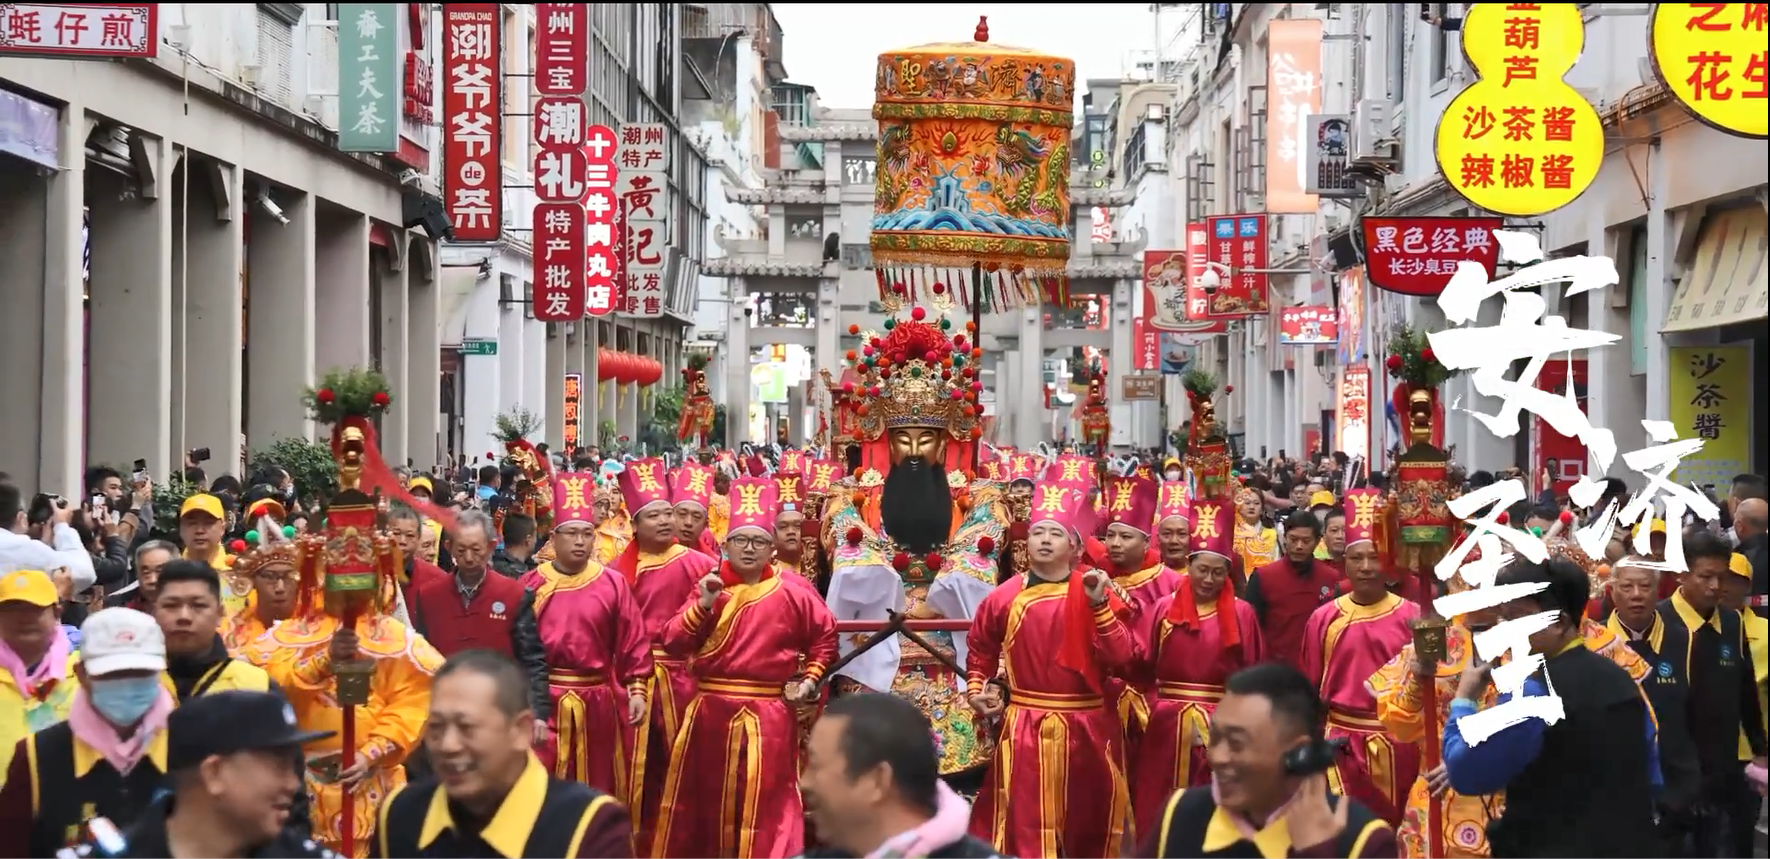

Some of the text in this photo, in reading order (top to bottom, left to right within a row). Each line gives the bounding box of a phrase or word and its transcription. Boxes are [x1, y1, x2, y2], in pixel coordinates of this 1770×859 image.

[8, 9, 134, 46] 蚝仔煎
[449, 12, 493, 21] GRANDPA CHAO
[548, 3, 574, 90] 州三宝
[1502, 3, 1541, 88] 葫芦
[622, 127, 663, 145] 潮州
[1462, 106, 1576, 141] 沙茶酱
[538, 102, 583, 198] 潮礼
[622, 150, 663, 168] 特产
[1461, 153, 1575, 189] 辣椒酱
[586, 133, 612, 309] 十三牛肉丸店
[1373, 226, 1492, 255] 黑色经典
[545, 210, 571, 316] 特产批发
[1388, 258, 1476, 275] 长沙臭豆
